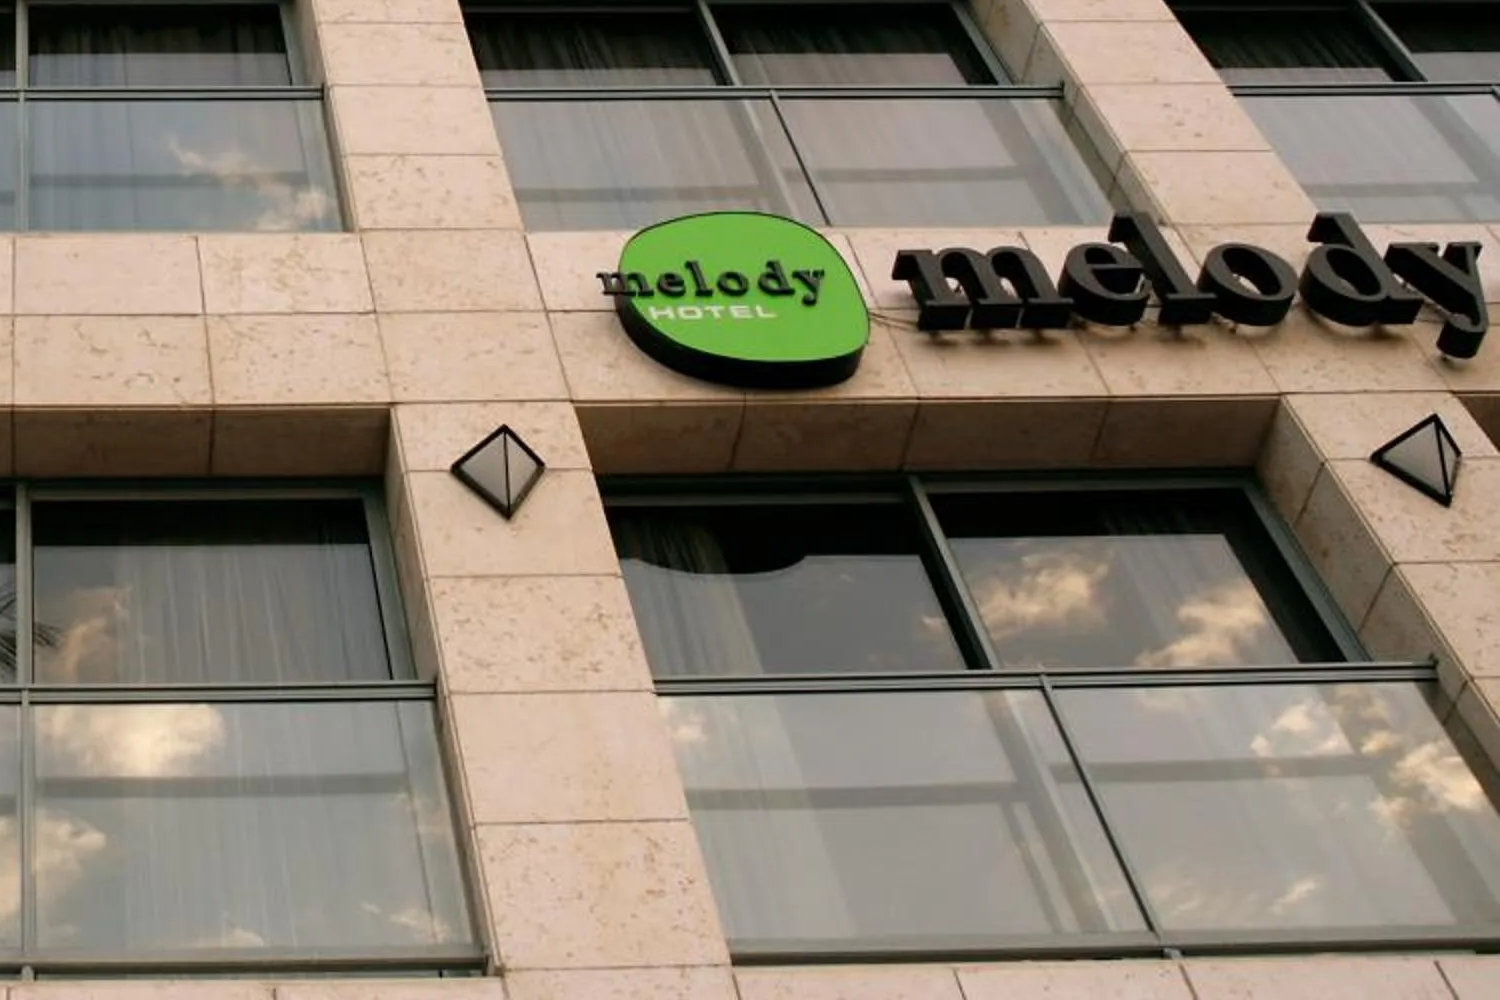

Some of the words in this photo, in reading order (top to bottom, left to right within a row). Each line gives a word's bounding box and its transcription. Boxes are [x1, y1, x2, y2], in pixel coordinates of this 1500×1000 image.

[596, 260, 825, 306] melody
[891, 212, 1486, 358] melody
[648, 304, 778, 321] HOTEL
